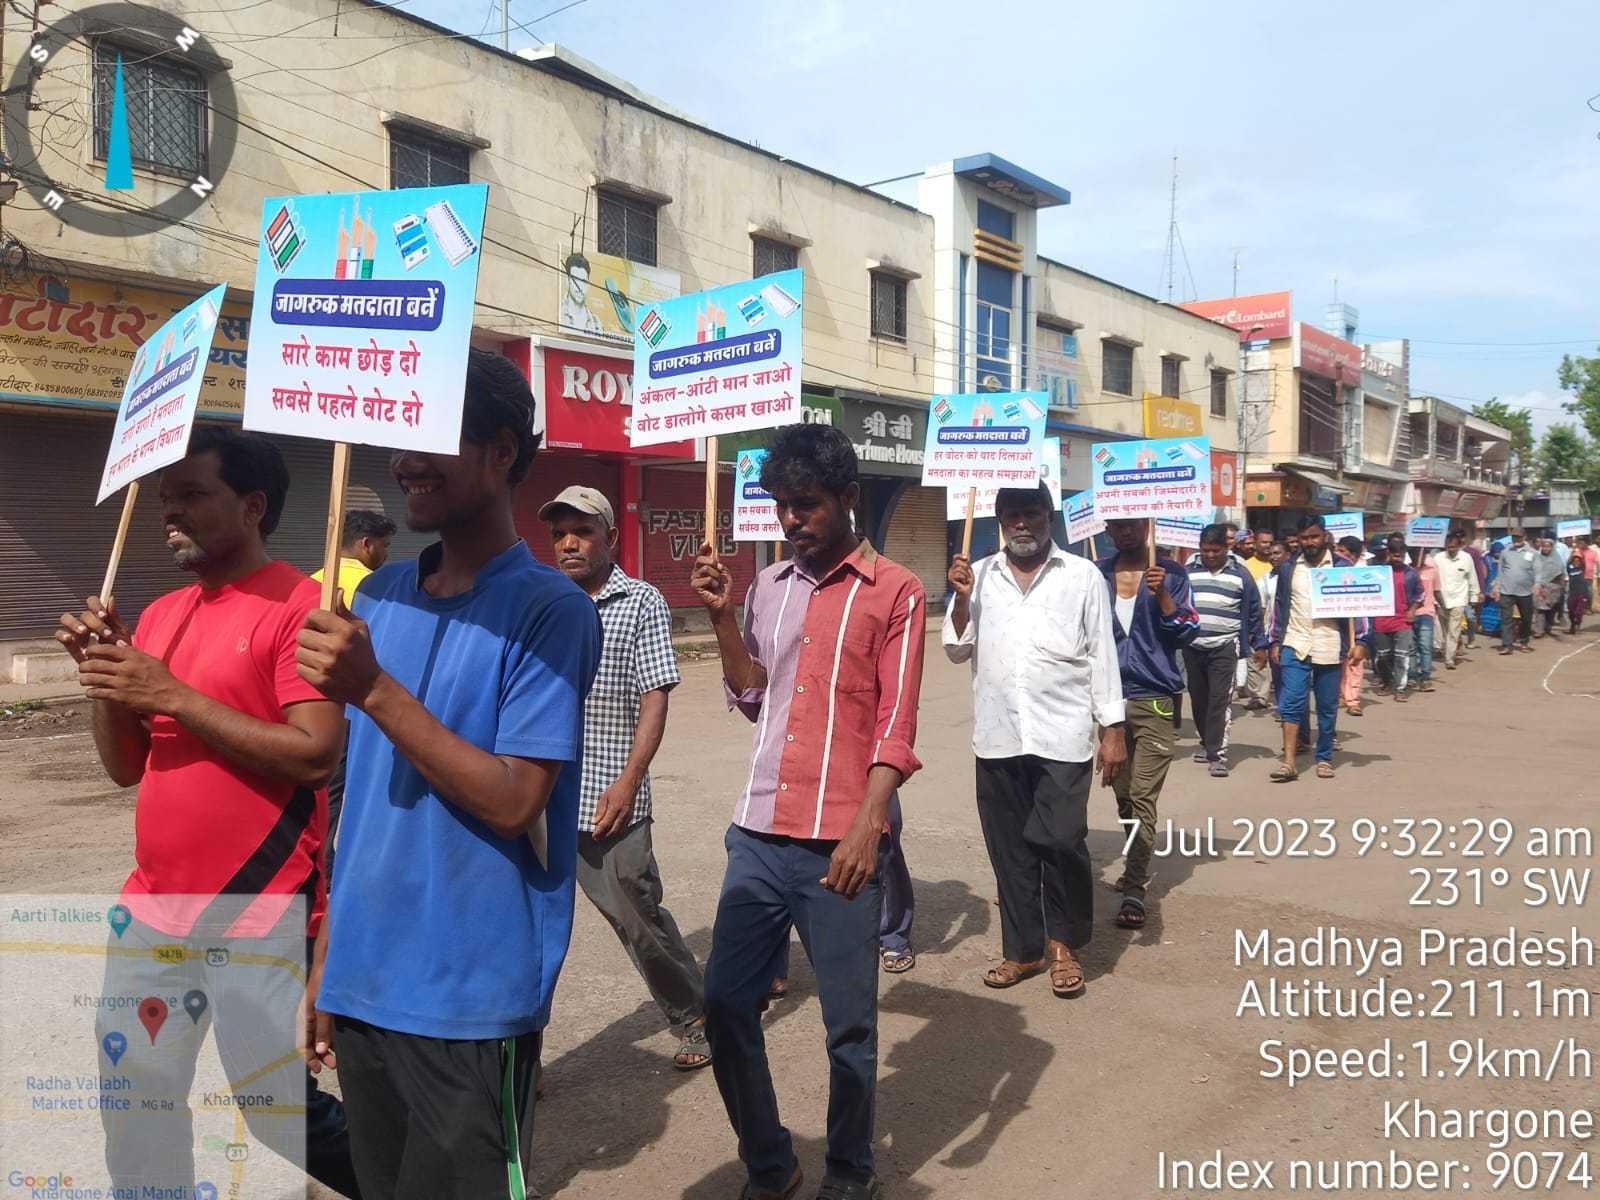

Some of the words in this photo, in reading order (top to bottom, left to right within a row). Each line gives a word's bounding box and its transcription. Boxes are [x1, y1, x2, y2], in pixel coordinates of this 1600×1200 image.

[275, 293, 337, 314] जागरुक
[340, 295, 404, 317] मतदाता
[406, 287, 440, 318] बनें
[282, 334, 310, 367] सारे
[316, 344, 352, 369] काम
[358, 338, 394, 376] छोड़
[400, 340, 421, 375] दो
[652, 354, 701, 373] जागरुक
[703, 343, 750, 364] मतदाता
[753, 332, 776, 356] बनें
[151, 368, 180, 394] मतदाता
[179, 351, 198, 377] बनें
[562, 365, 633, 406] ROY
[722, 372, 748, 392] मान
[753, 361, 792, 385] जाओ
[157, 394, 186, 419] मतदाता
[272, 381, 312, 414] सबसे
[317, 385, 358, 419] पहले
[363, 388, 396, 422] वोट
[402, 391, 423, 427] दो
[637, 410, 660, 432] वोट
[664, 405, 707, 430] डालोगे
[711, 403, 745, 422] कसम
[751, 391, 794, 416] खाओ
[157, 424, 186, 449] विधाता
[862, 411, 888, 437] श्री
[888, 414, 914, 440] जी
[975, 431, 1009, 441] मतदाता
[853, 439, 895, 463] erfume
[896, 443, 925, 466] Hous
[934, 451, 944, 461] हर
[945, 448, 963, 460] वोटर
[966, 448, 977, 460] को
[980, 451, 996, 460] याद
[998, 448, 1033, 461] दिलाओ
[928, 468, 956, 478] मतदाता
[959, 468, 969, 478] का
[972, 468, 994, 480] महत्व
[997, 467, 1036, 481] समझाओ
[744, 486, 769, 497] जागरु
